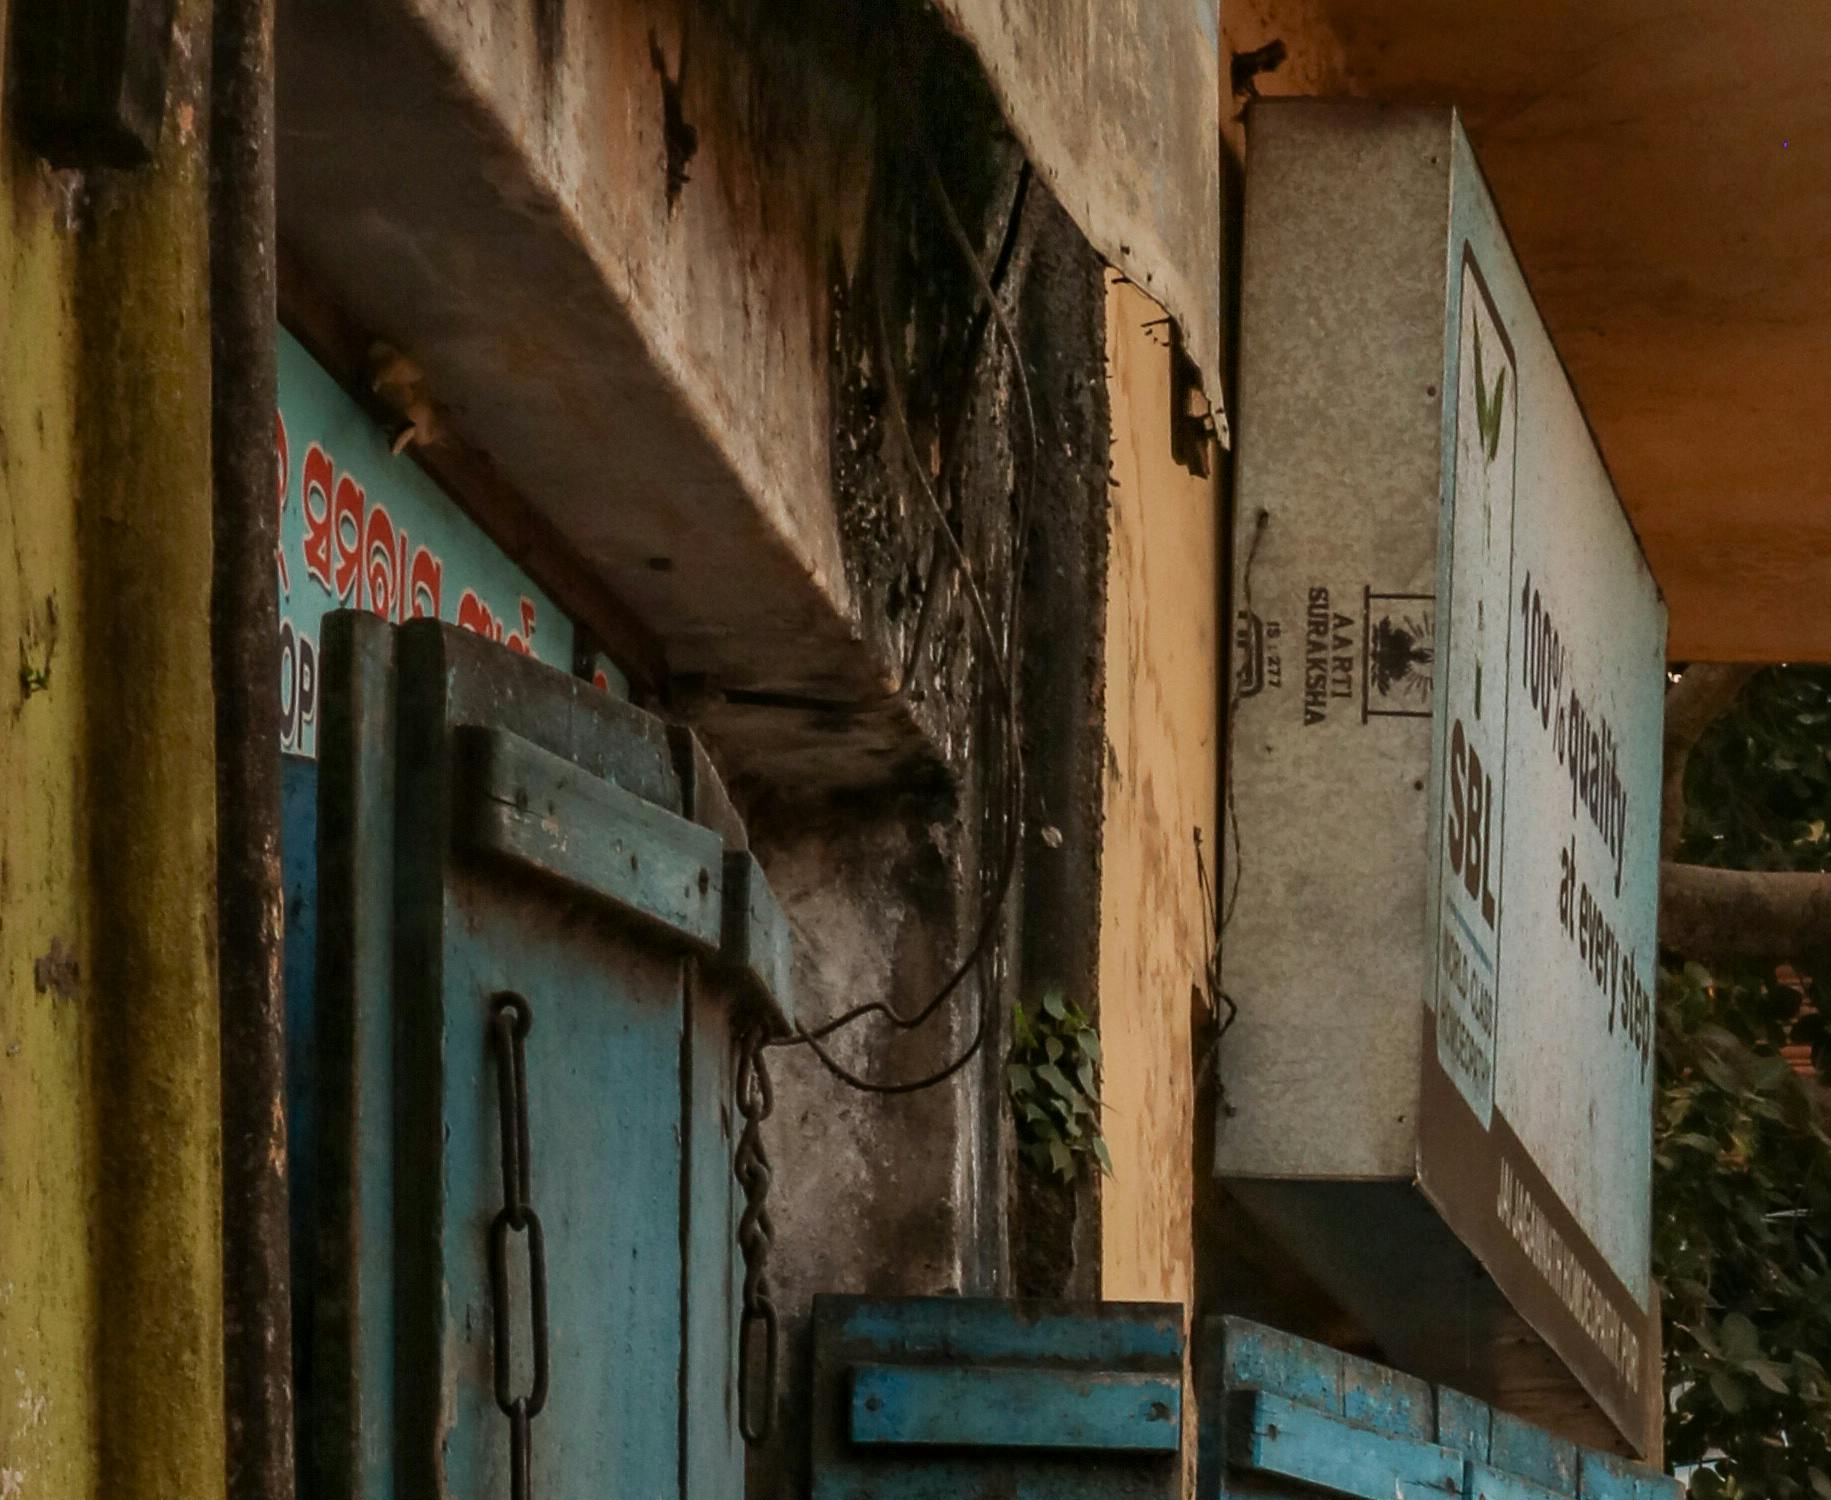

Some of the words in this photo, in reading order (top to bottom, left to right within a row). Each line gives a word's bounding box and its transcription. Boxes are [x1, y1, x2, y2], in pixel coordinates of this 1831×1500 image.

[1267, 655, 1282, 688] 277
[1304, 587, 1329, 726] SURAKSHA
[1331, 612, 1354, 698] AARTI
[1521, 570, 1565, 766] 100%
[1568, 688, 1627, 899] quality
[1449, 718, 1495, 931] SBL
[1559, 833, 1576, 941] at
[1579, 882, 1620, 1037] every
[1621, 948, 1650, 1085] step
